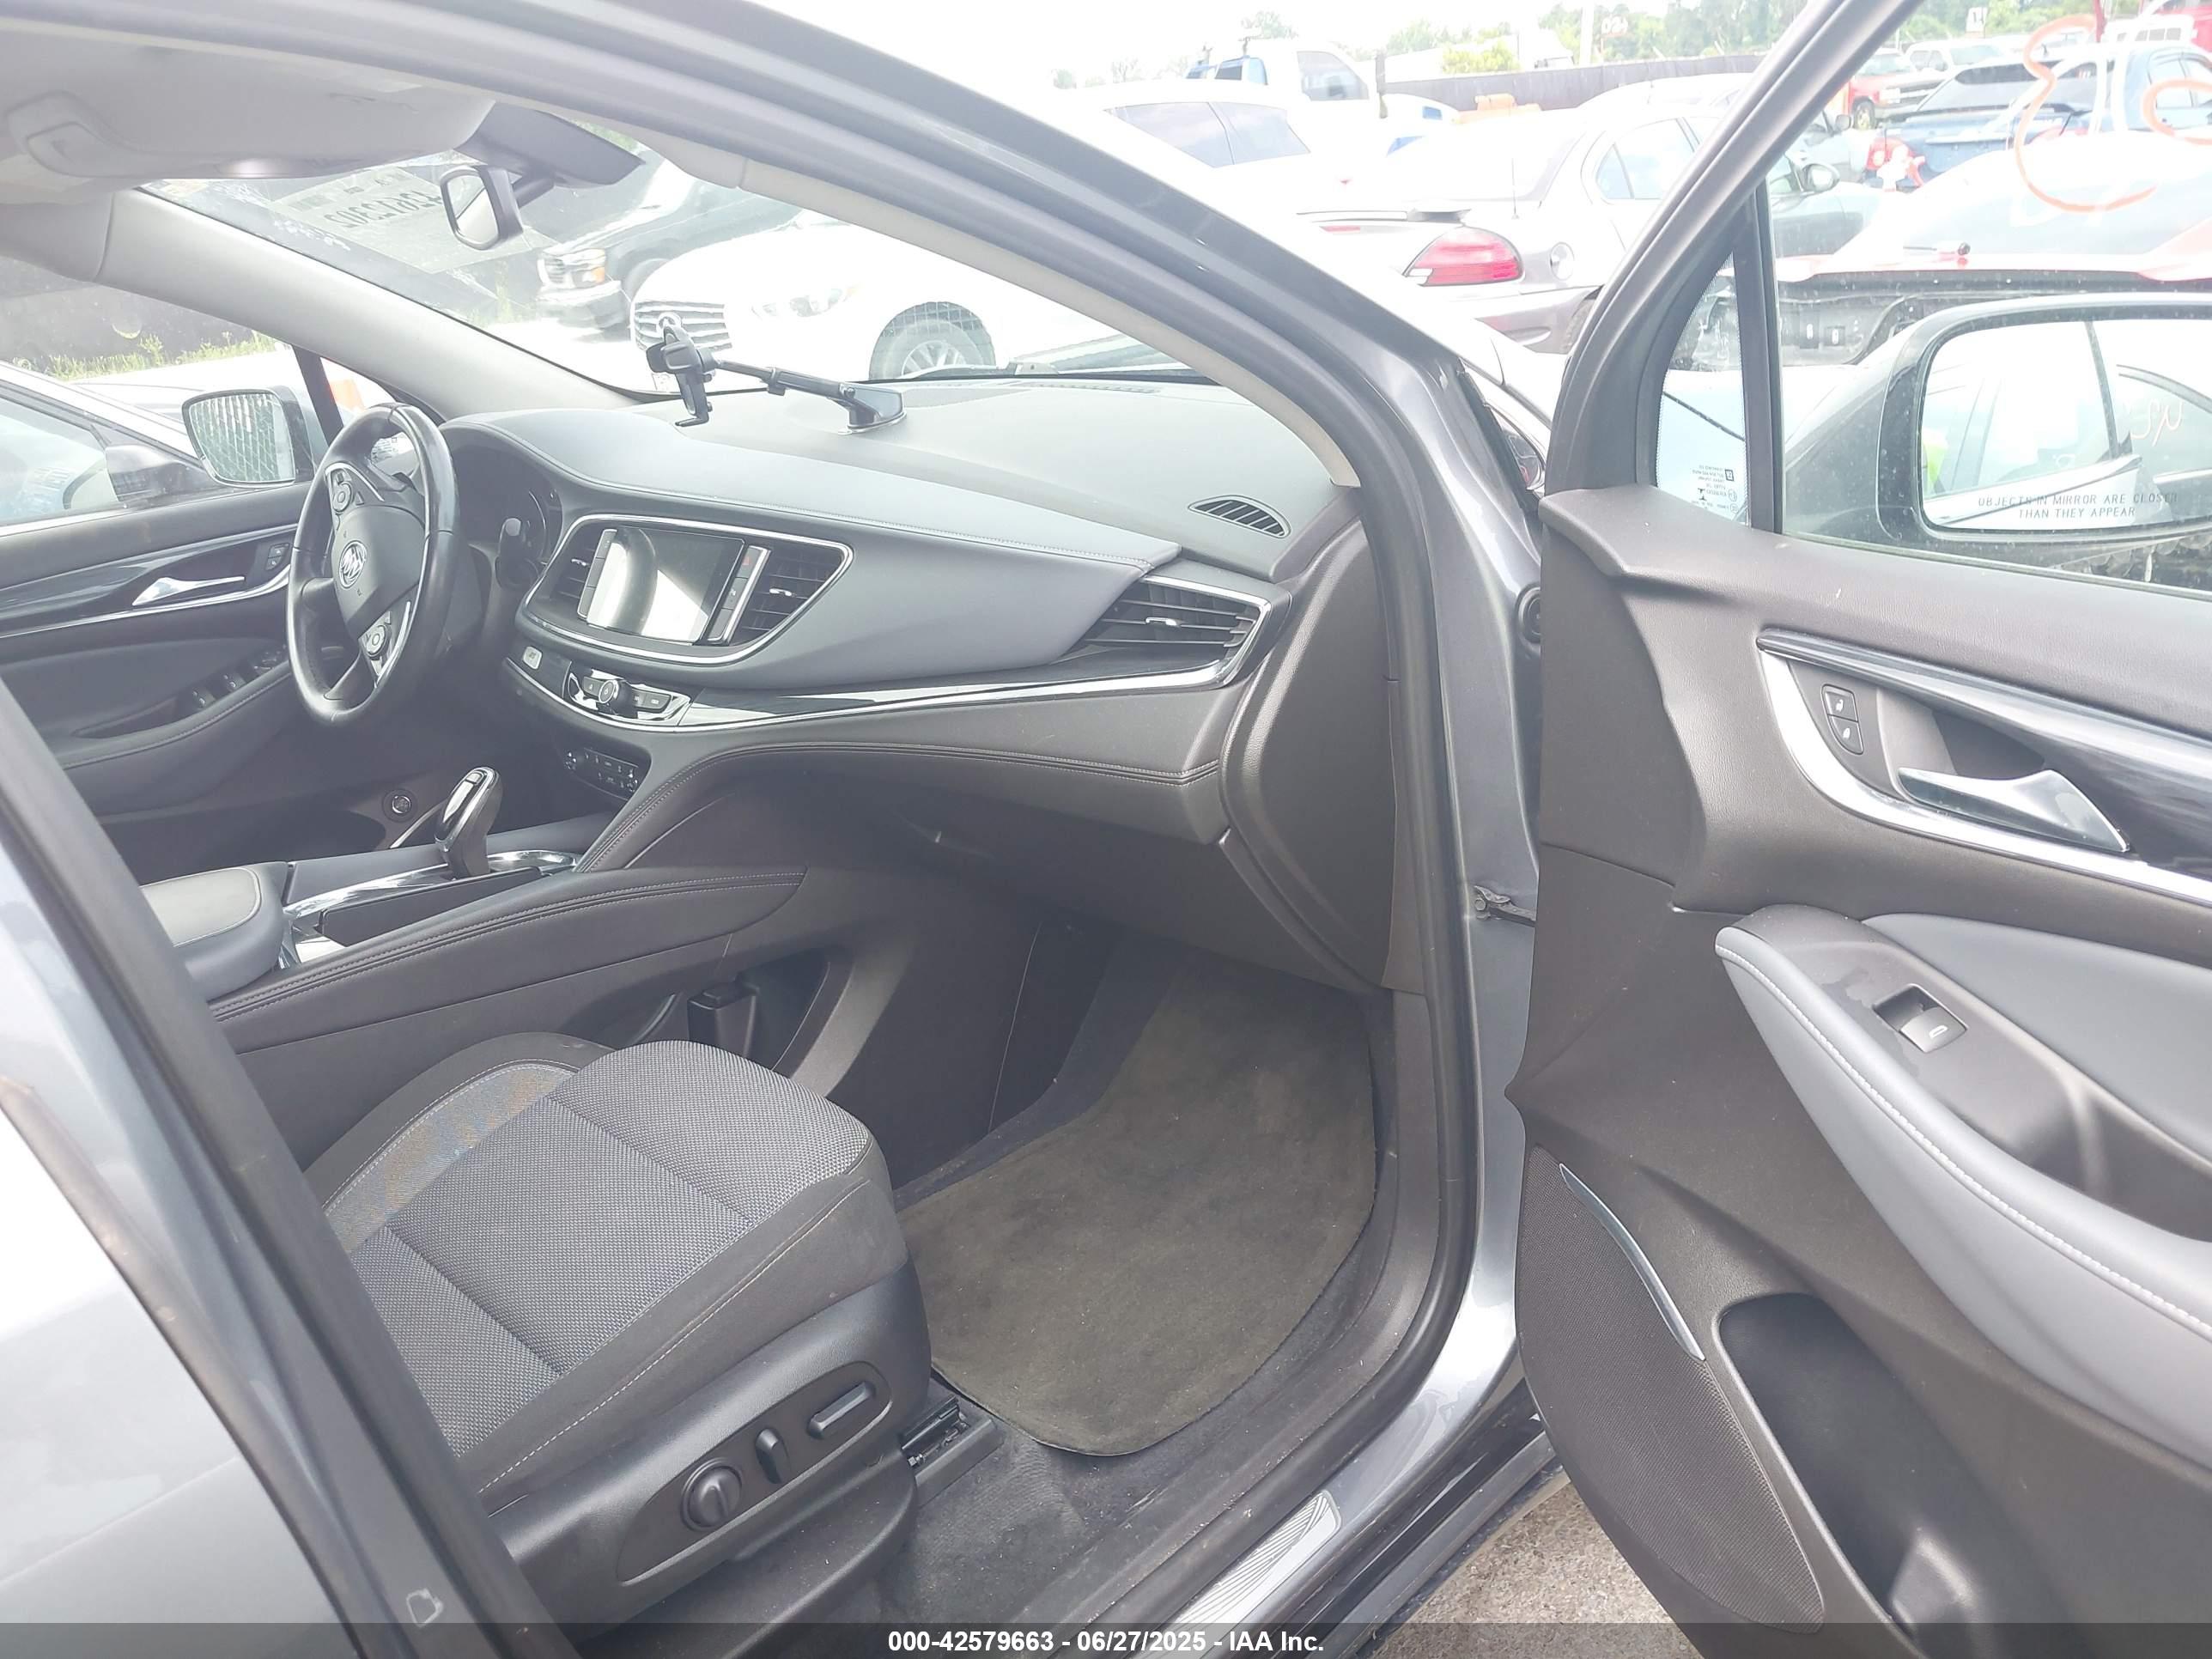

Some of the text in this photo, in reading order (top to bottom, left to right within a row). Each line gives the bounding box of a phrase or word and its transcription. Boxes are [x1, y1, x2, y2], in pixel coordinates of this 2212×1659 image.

[1978, 495, 2032, 507] OBJECTS
[2036, 495, 2048, 506] IN
[2051, 494, 2097, 505] MIRROR
[2104, 493, 2126, 504] ARE
[2019, 507, 2136, 519] THAN THEY APPEAR
